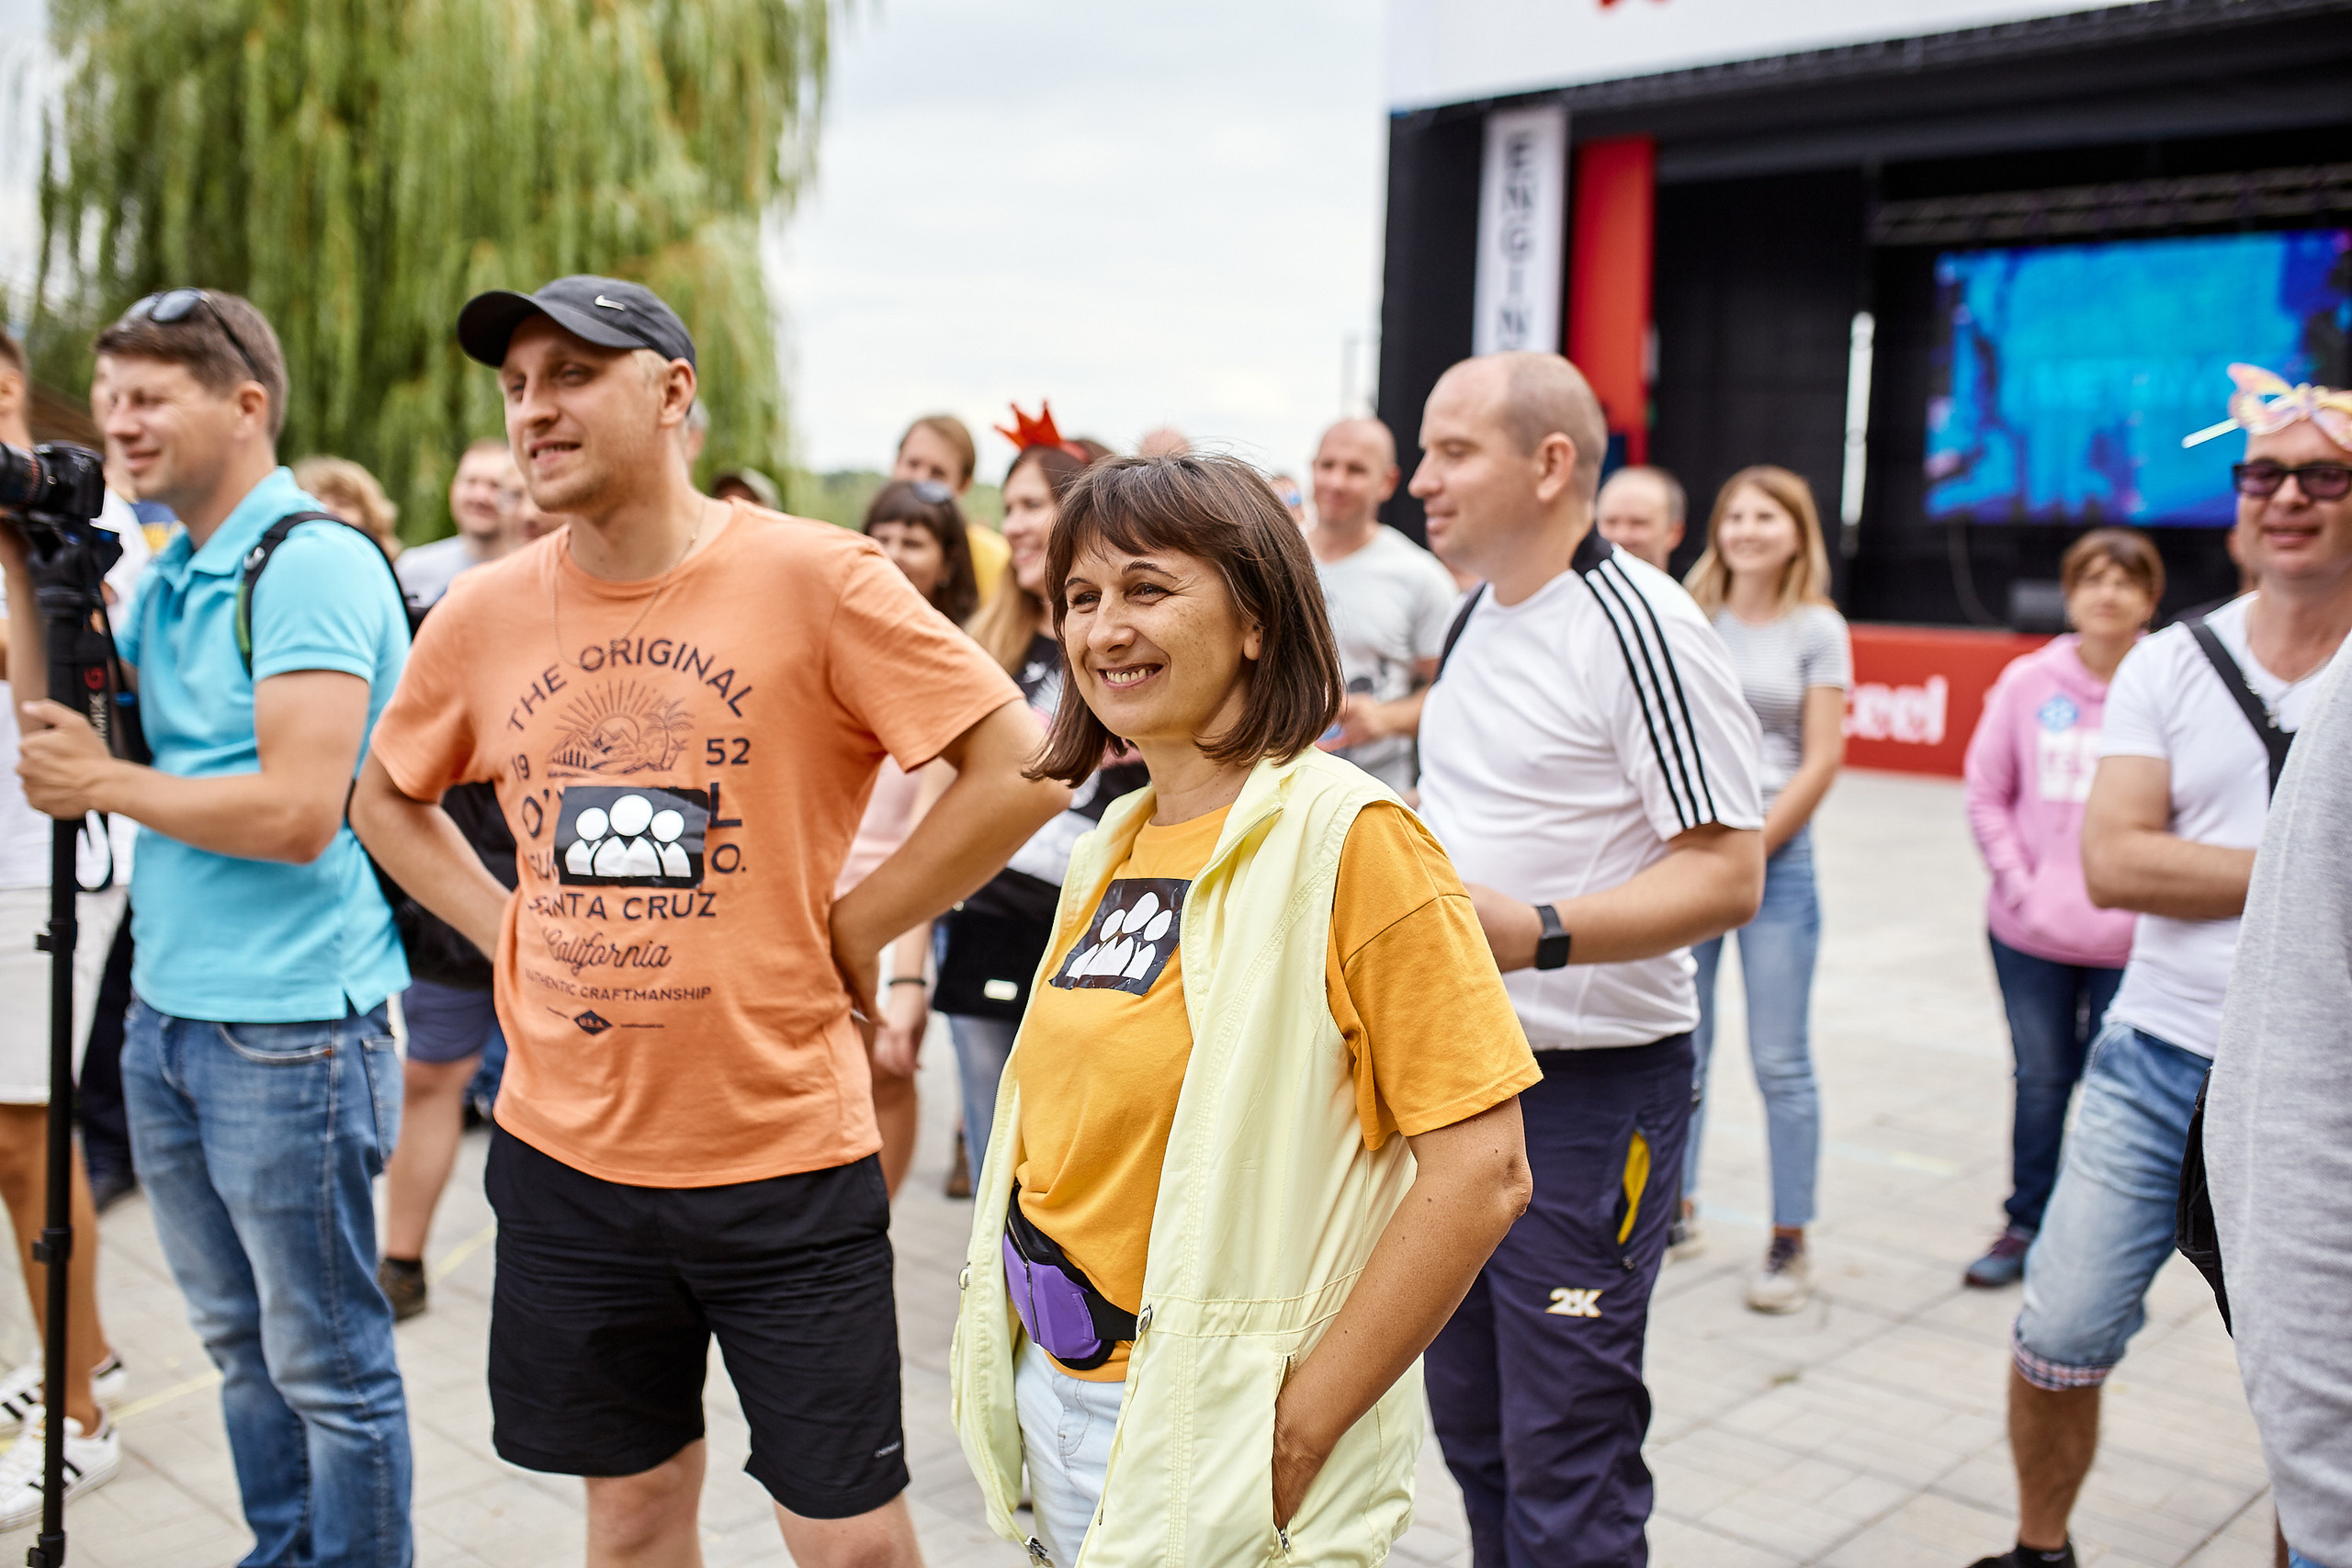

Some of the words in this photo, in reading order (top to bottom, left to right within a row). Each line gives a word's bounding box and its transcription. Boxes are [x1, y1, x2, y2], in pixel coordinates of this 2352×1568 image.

[1497, 133, 1537, 352] ENGIN
[507, 663, 567, 732] THE
[579, 637, 752, 718] ORIGINAL
[706, 738, 751, 766] 52
[623, 893, 717, 919] CRUZ
[542, 925, 673, 976] California
[580, 986, 712, 1001] CRAFTMANSHIP
[1544, 1286, 1604, 1318] 2K
